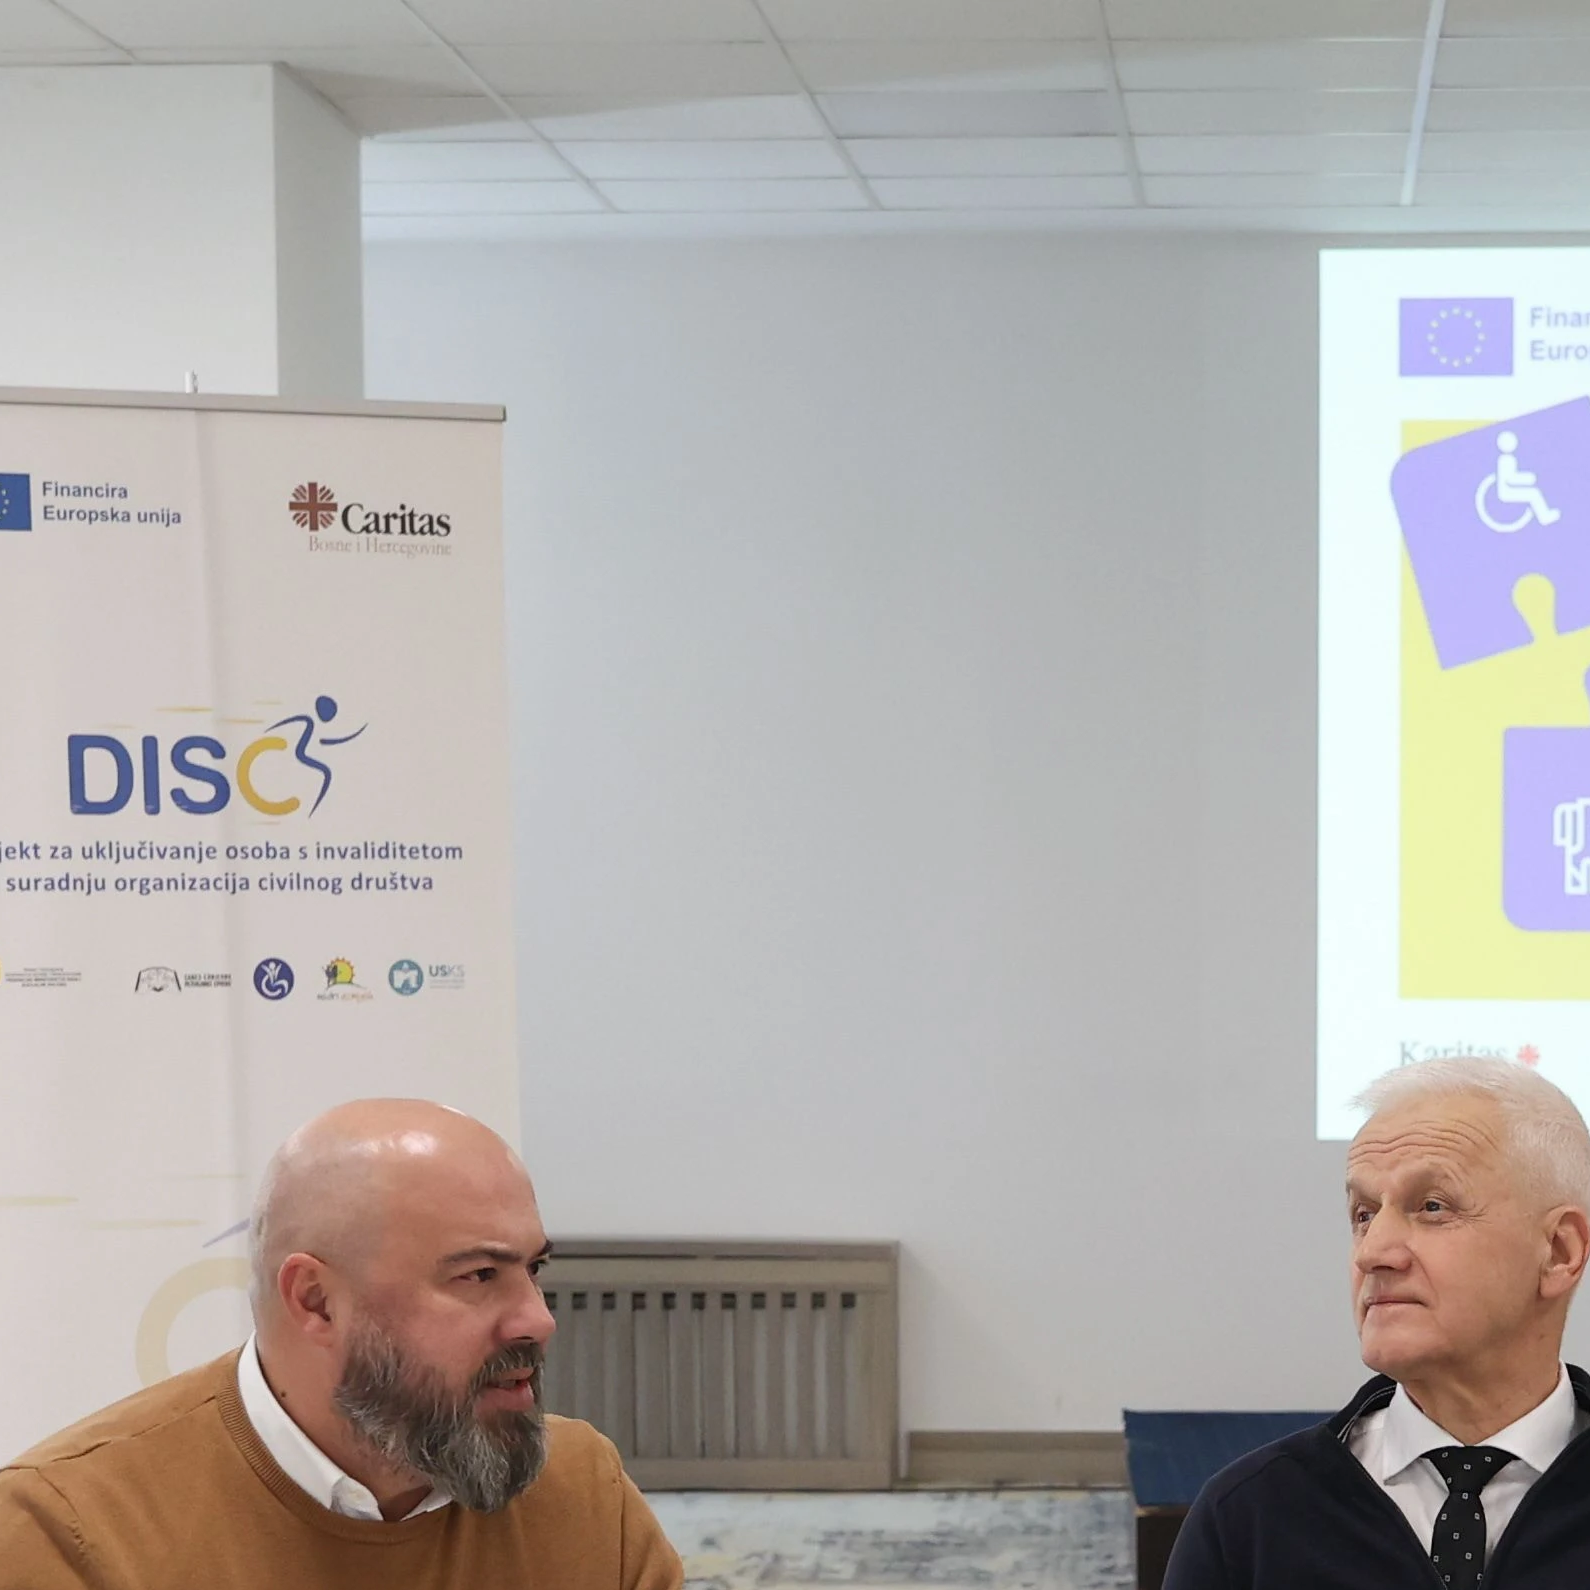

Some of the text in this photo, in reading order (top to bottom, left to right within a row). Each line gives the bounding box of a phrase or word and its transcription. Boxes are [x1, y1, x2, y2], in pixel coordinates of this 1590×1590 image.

[42, 481, 129, 499] Financira
[43, 505, 182, 528] Europska unija
[341, 502, 452, 537] Caritas
[308, 535, 352, 553] Bosne
[366, 537, 452, 559] Hercegovine
[67, 733, 301, 817] DISC
[49, 845, 72, 860] za
[81, 840, 218, 864] uključivanje
[225, 841, 290, 860] osoba
[298, 845, 308, 860] s
[316, 841, 464, 860] invaliditetom
[6, 872, 107, 896] suradnju
[114, 872, 250, 896] organizacija
[258, 872, 343, 895] civilnog
[351, 872, 434, 891] društva
